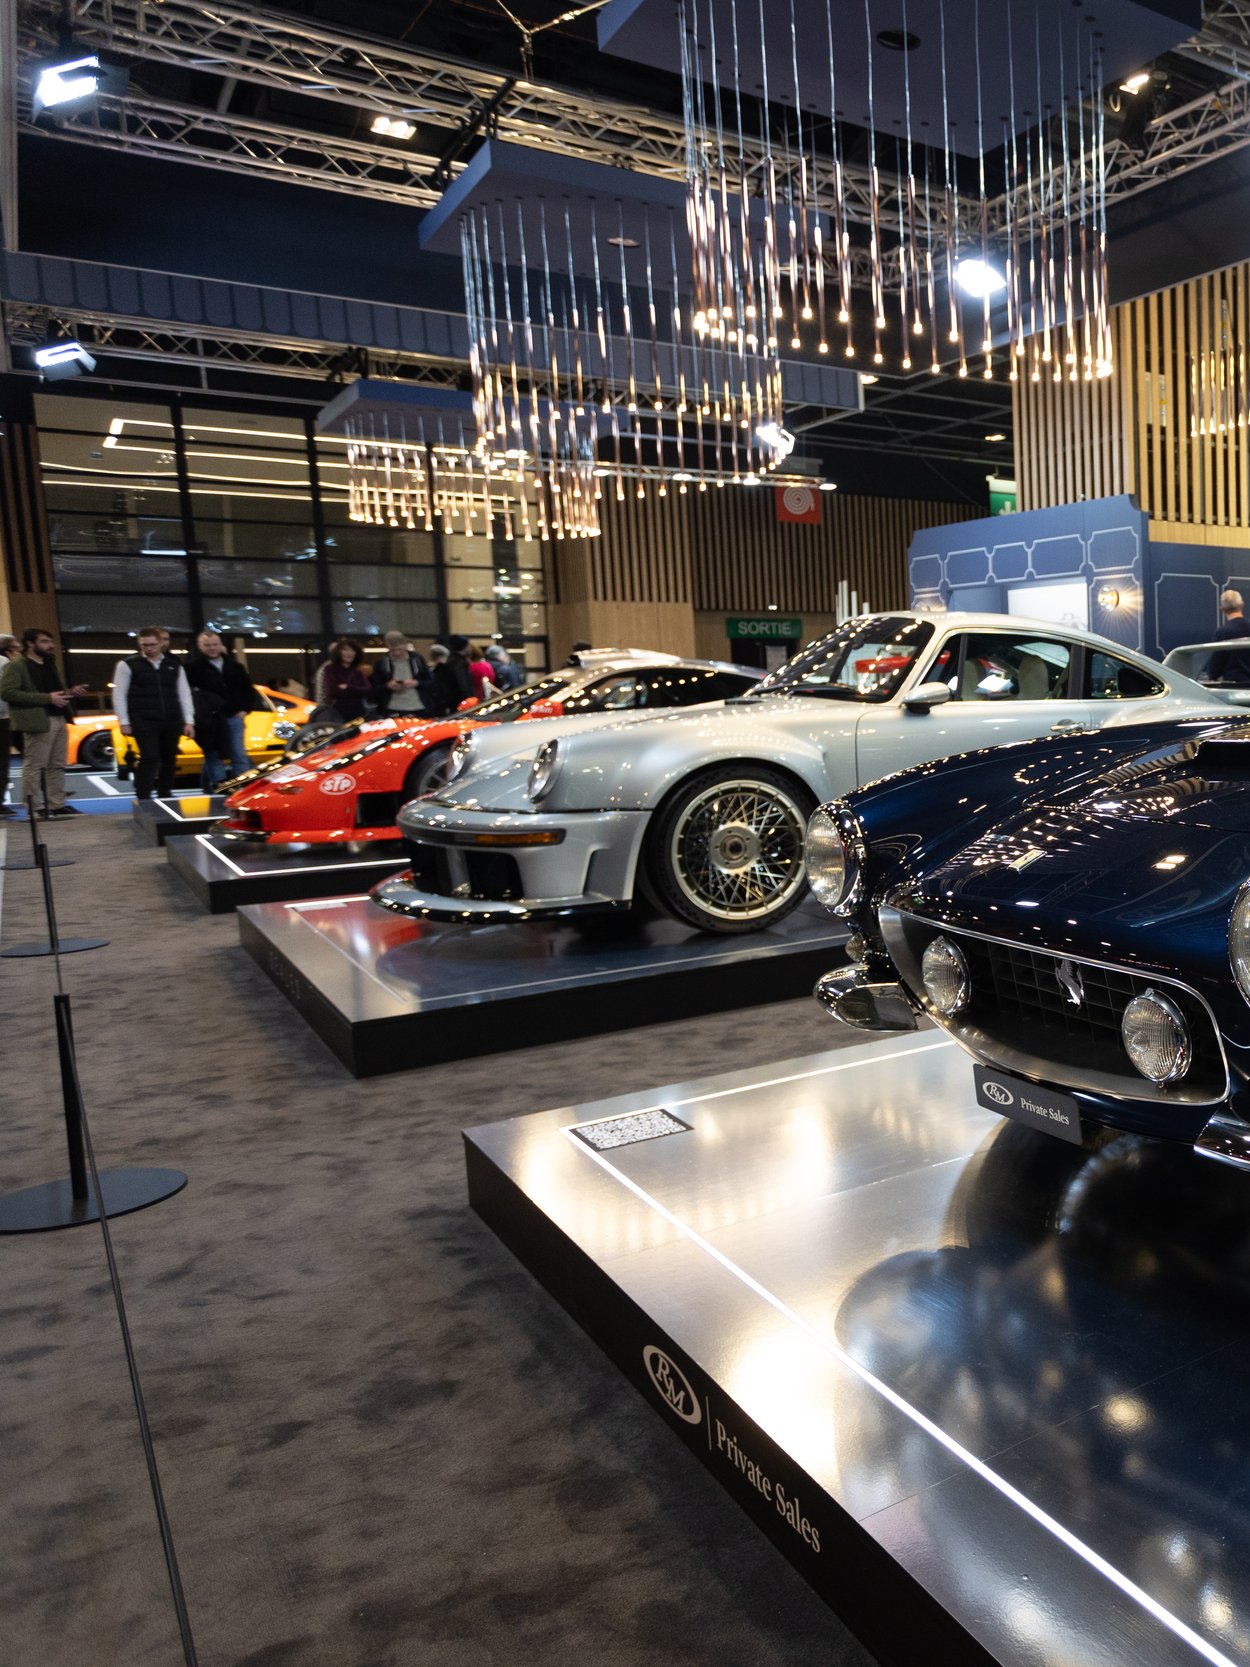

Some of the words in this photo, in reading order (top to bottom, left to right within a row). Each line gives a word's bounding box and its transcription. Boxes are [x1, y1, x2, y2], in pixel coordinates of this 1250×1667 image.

[738, 621, 791, 635] SORTIE
[323, 776, 352, 792] STP
[1019, 1097, 1048, 1117] Private
[1048, 1107, 1070, 1125] Sales
[715, 1418, 773, 1501] Private
[775, 1482, 820, 1553] Sales
